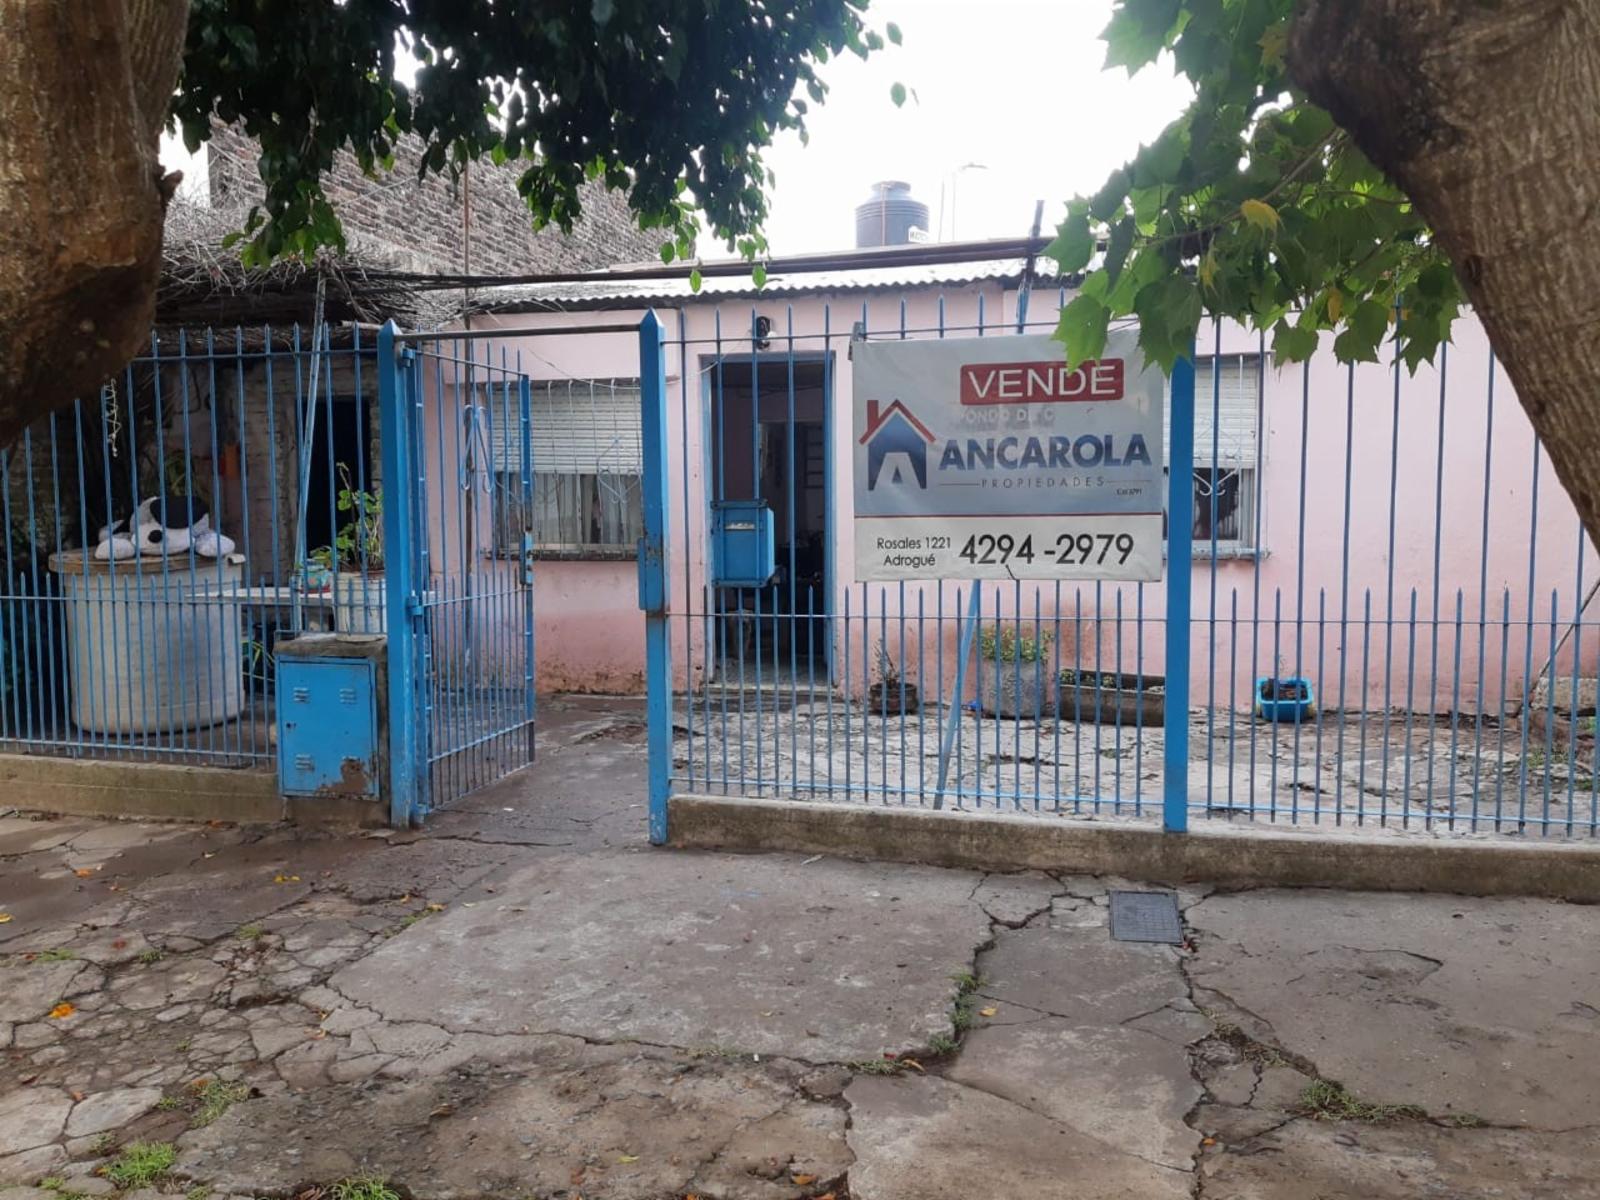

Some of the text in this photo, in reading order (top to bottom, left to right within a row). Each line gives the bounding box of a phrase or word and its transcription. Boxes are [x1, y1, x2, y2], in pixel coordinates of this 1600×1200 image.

[968, 365, 1116, 399] VENDE
[938, 434, 1152, 470] ANCAROLA
[981, 477, 1105, 488] PROPIEDADES
[877, 537, 951, 549] Rosales 1221
[959, 533, 1134, 565] 4294 -2979
[883, 553, 936, 568] Adrogué
